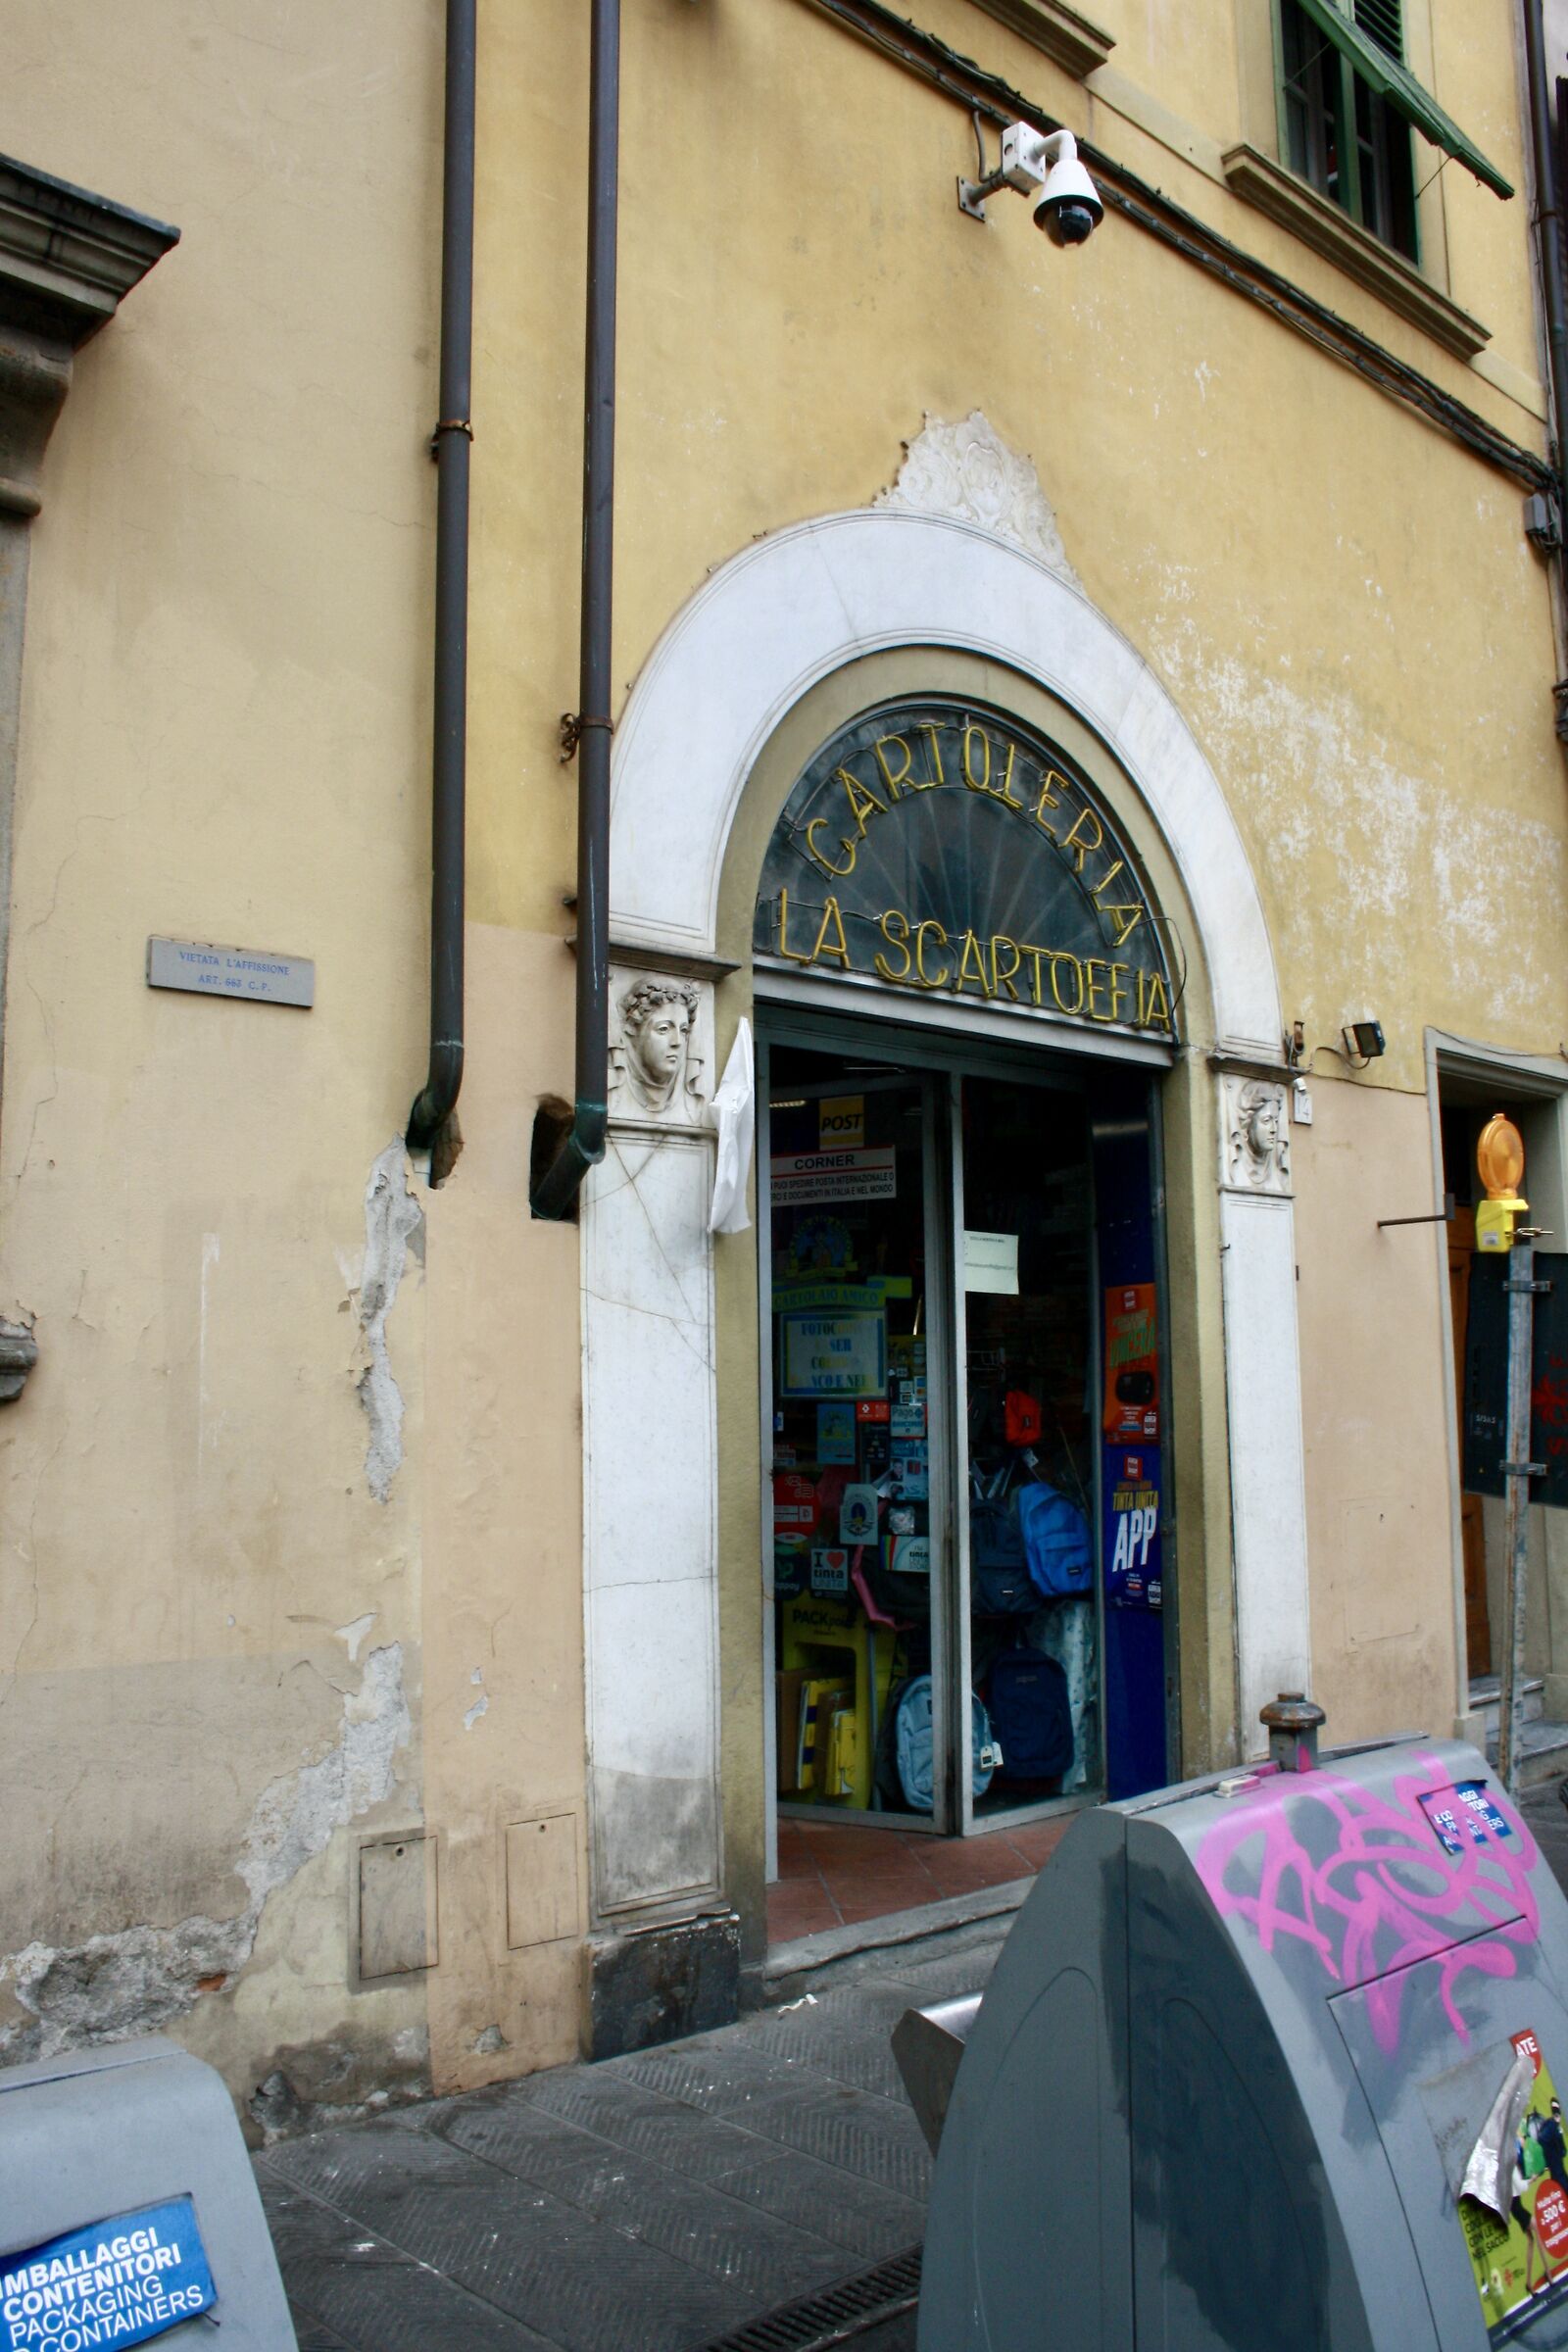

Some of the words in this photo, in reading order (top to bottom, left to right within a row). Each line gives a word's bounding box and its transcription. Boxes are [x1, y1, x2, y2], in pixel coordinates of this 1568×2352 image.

[807, 722, 1145, 948] CARTOLERIA
[779, 887, 851, 970] LA
[179, 951, 220, 965] VIETATA
[226, 958, 290, 976] L'AFFISSIONE
[198, 974, 221, 986] ART.
[821, 1113, 861, 1132] POST
[794, 1154, 856, 1170] CORNER
[1111, 1504, 1157, 1573] APP
[4, 2243, 181, 2322] CONTENITORI
[9, 2275, 164, 2347] PACKAGING
[40, 2285, 204, 2352] CONTAINERS
